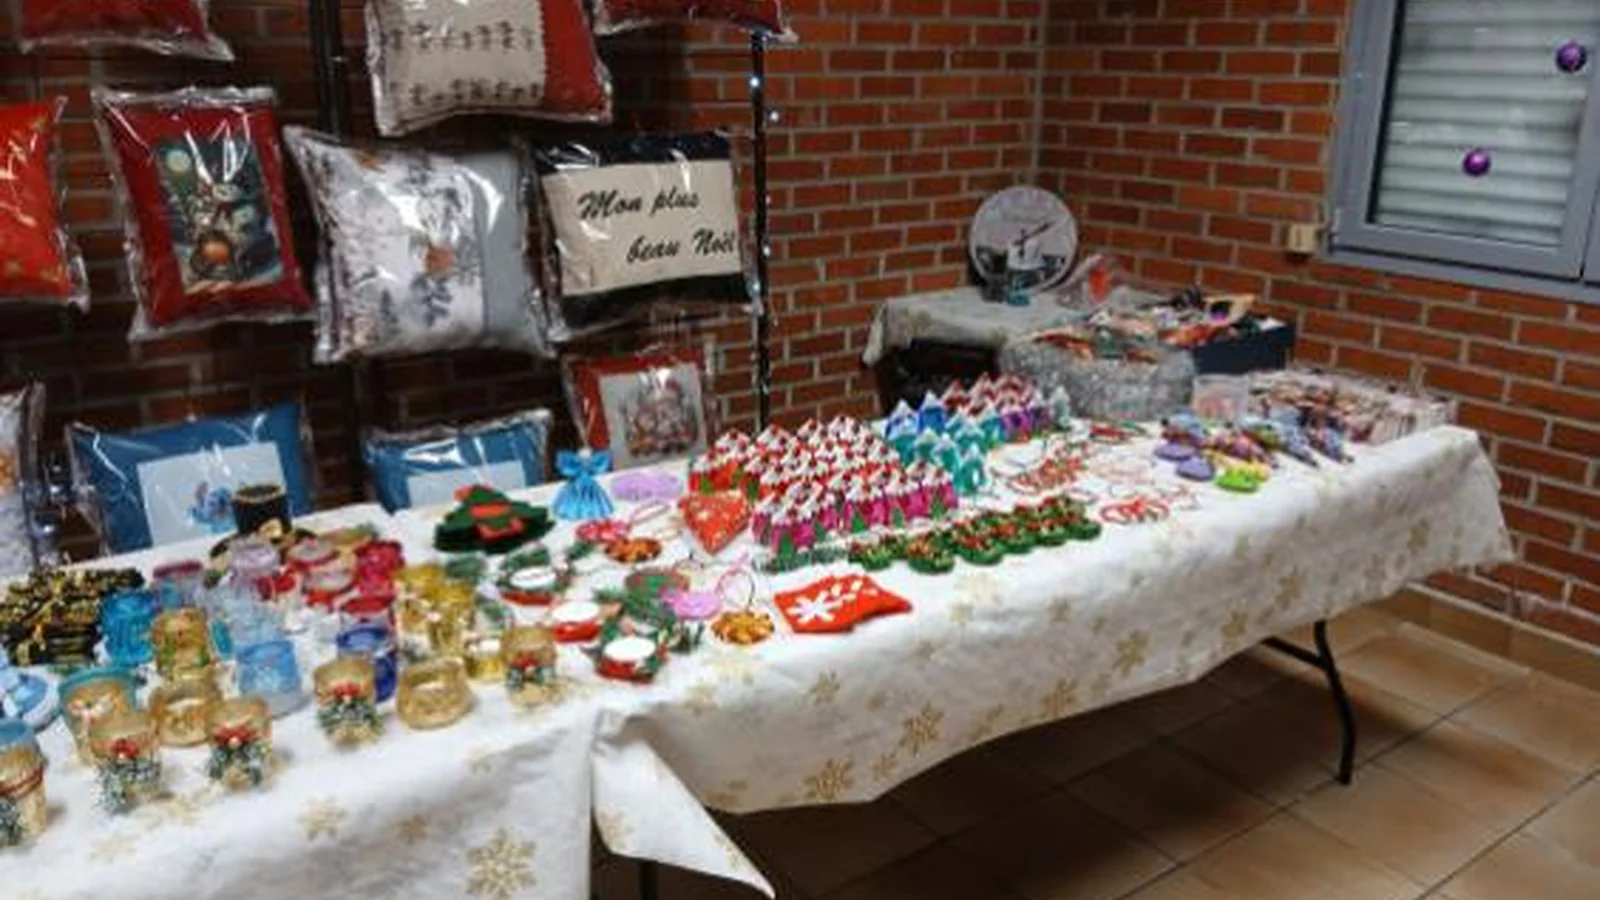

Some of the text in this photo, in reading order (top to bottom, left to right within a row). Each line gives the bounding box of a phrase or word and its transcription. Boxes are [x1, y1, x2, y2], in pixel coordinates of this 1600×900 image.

[577, 185, 699, 219] Mon plus
[626, 235, 681, 263] beau
